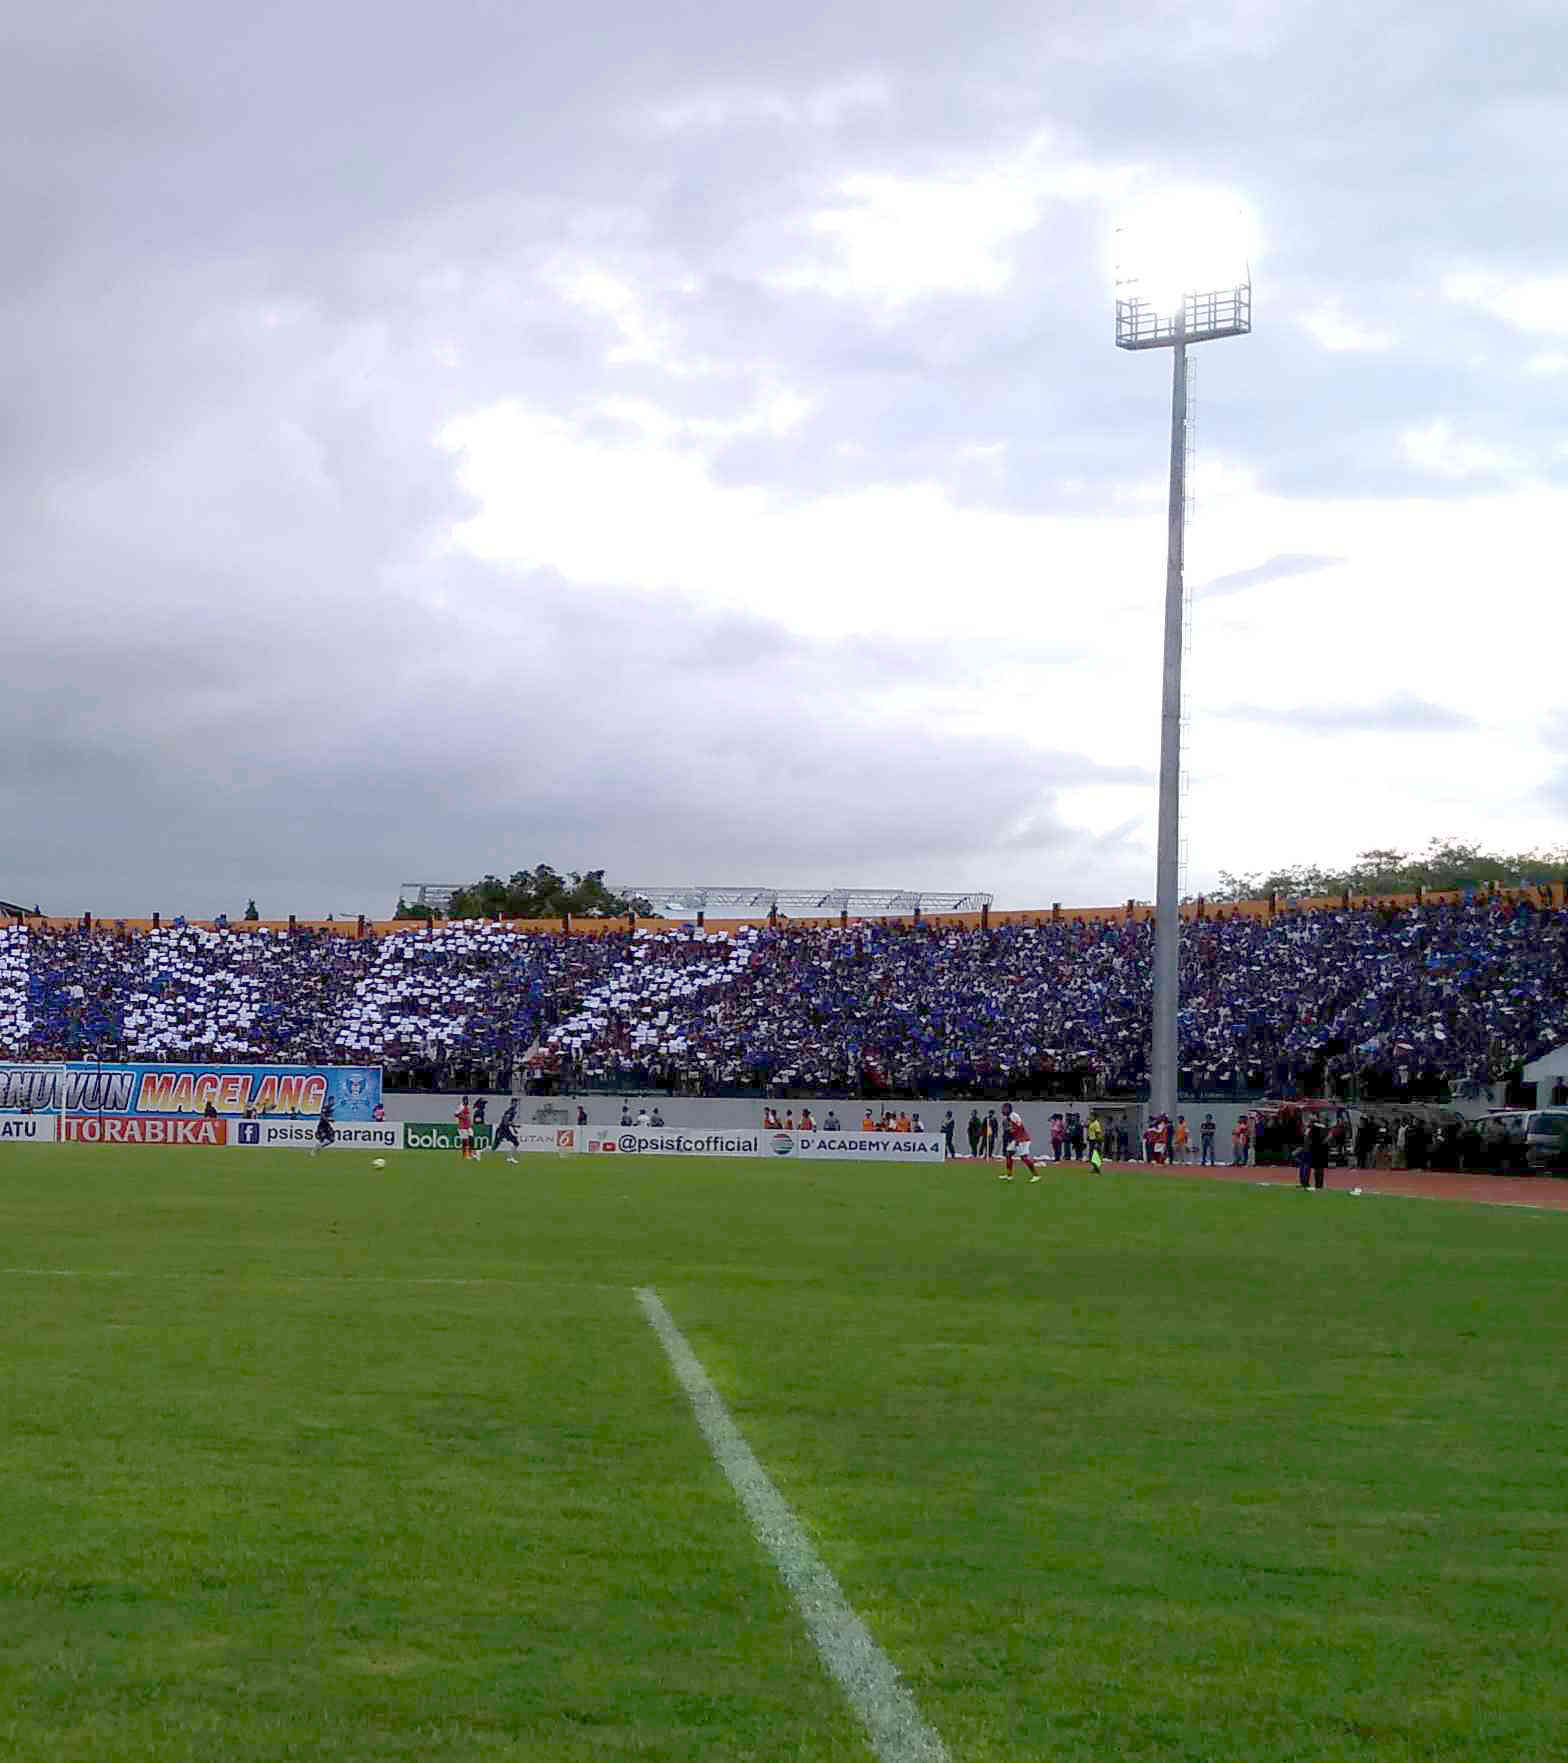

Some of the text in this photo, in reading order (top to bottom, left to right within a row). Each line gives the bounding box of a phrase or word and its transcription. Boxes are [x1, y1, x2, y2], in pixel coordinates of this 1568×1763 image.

[136, 1072, 327, 1114] MAGELANG
[66, 1119, 218, 1144] TORABIKA
[408, 1128, 489, 1148] bola.cm
[618, 1134, 758, 1153] @psisfcofficial
[817, 1140, 890, 1152] ACADEMY
[892, 1141, 927, 1153] ASIA
[930, 1142, 940, 1153] 4
